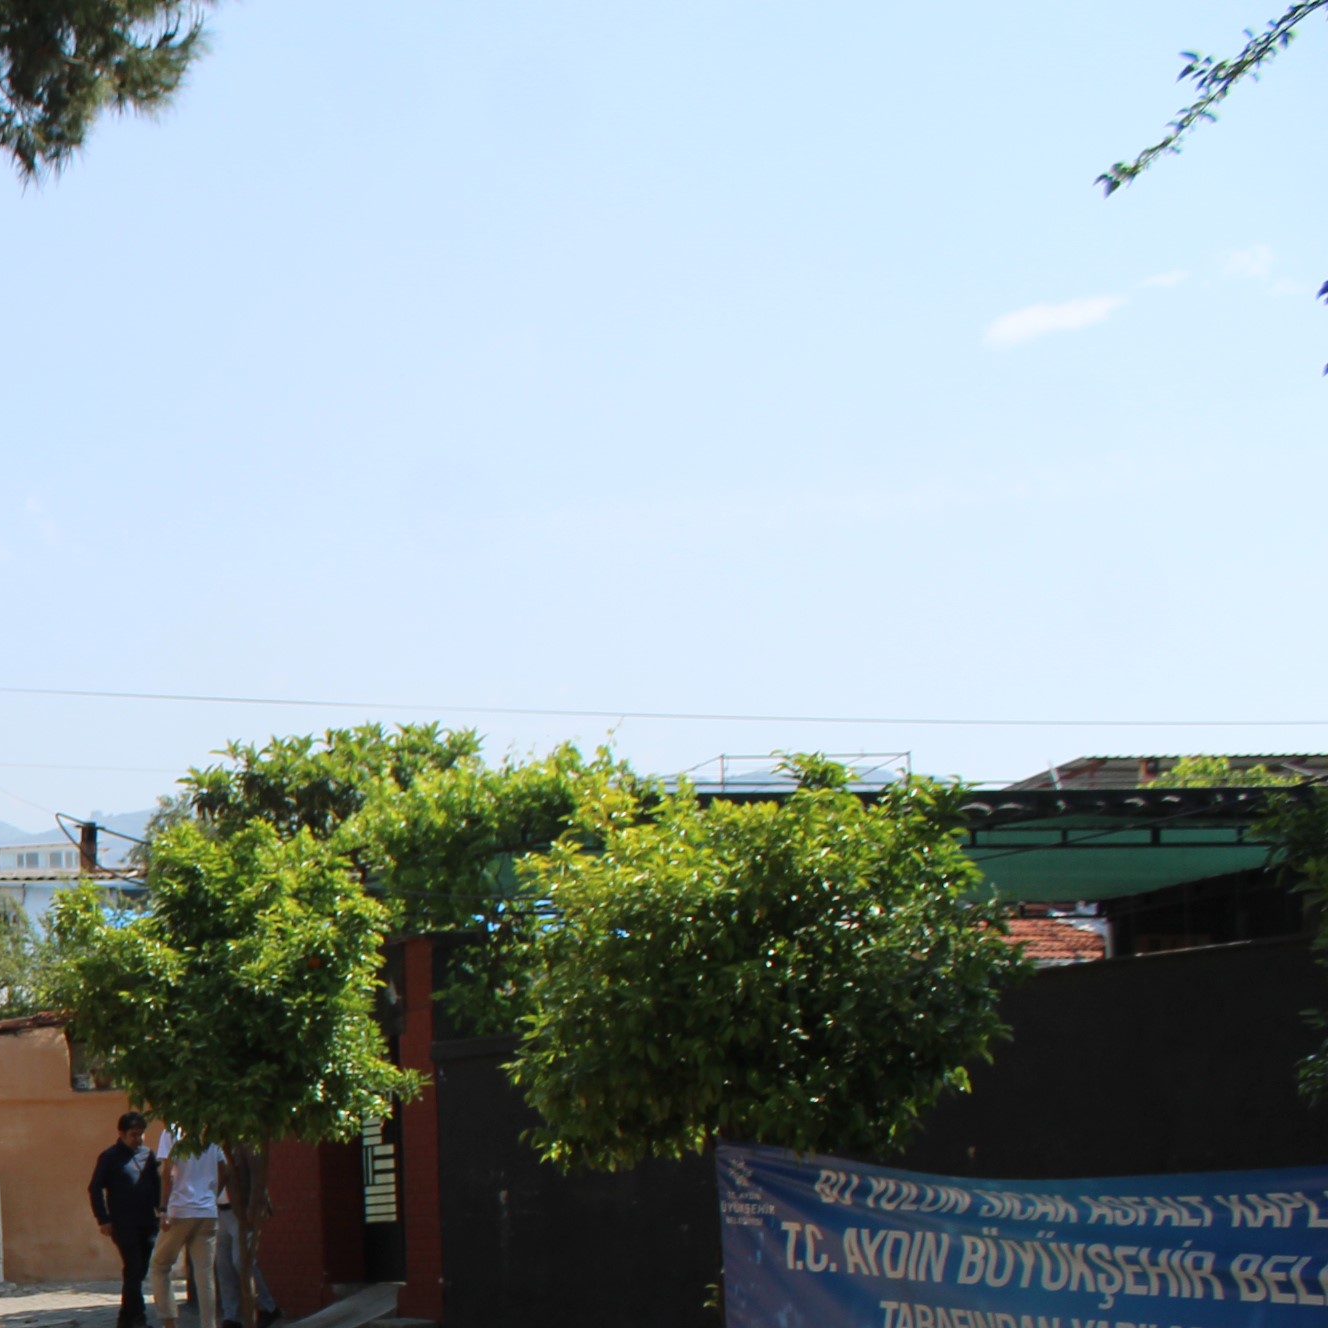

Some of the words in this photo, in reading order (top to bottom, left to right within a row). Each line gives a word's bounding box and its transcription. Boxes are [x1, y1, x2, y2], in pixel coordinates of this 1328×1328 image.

[814, 1169, 859, 1205] BU
[866, 1176, 971, 1214] YOLUN
[974, 1188, 1078, 1224] SICAK
[1079, 1195, 1213, 1228] ASFALT
[1214, 1191, 1328, 1228] KAPL
[781, 1221, 837, 1273] T.C.
[844, 1227, 950, 1283] AYDIN
[957, 1226, 1225, 1310] BÜYÜKŞEHİR
